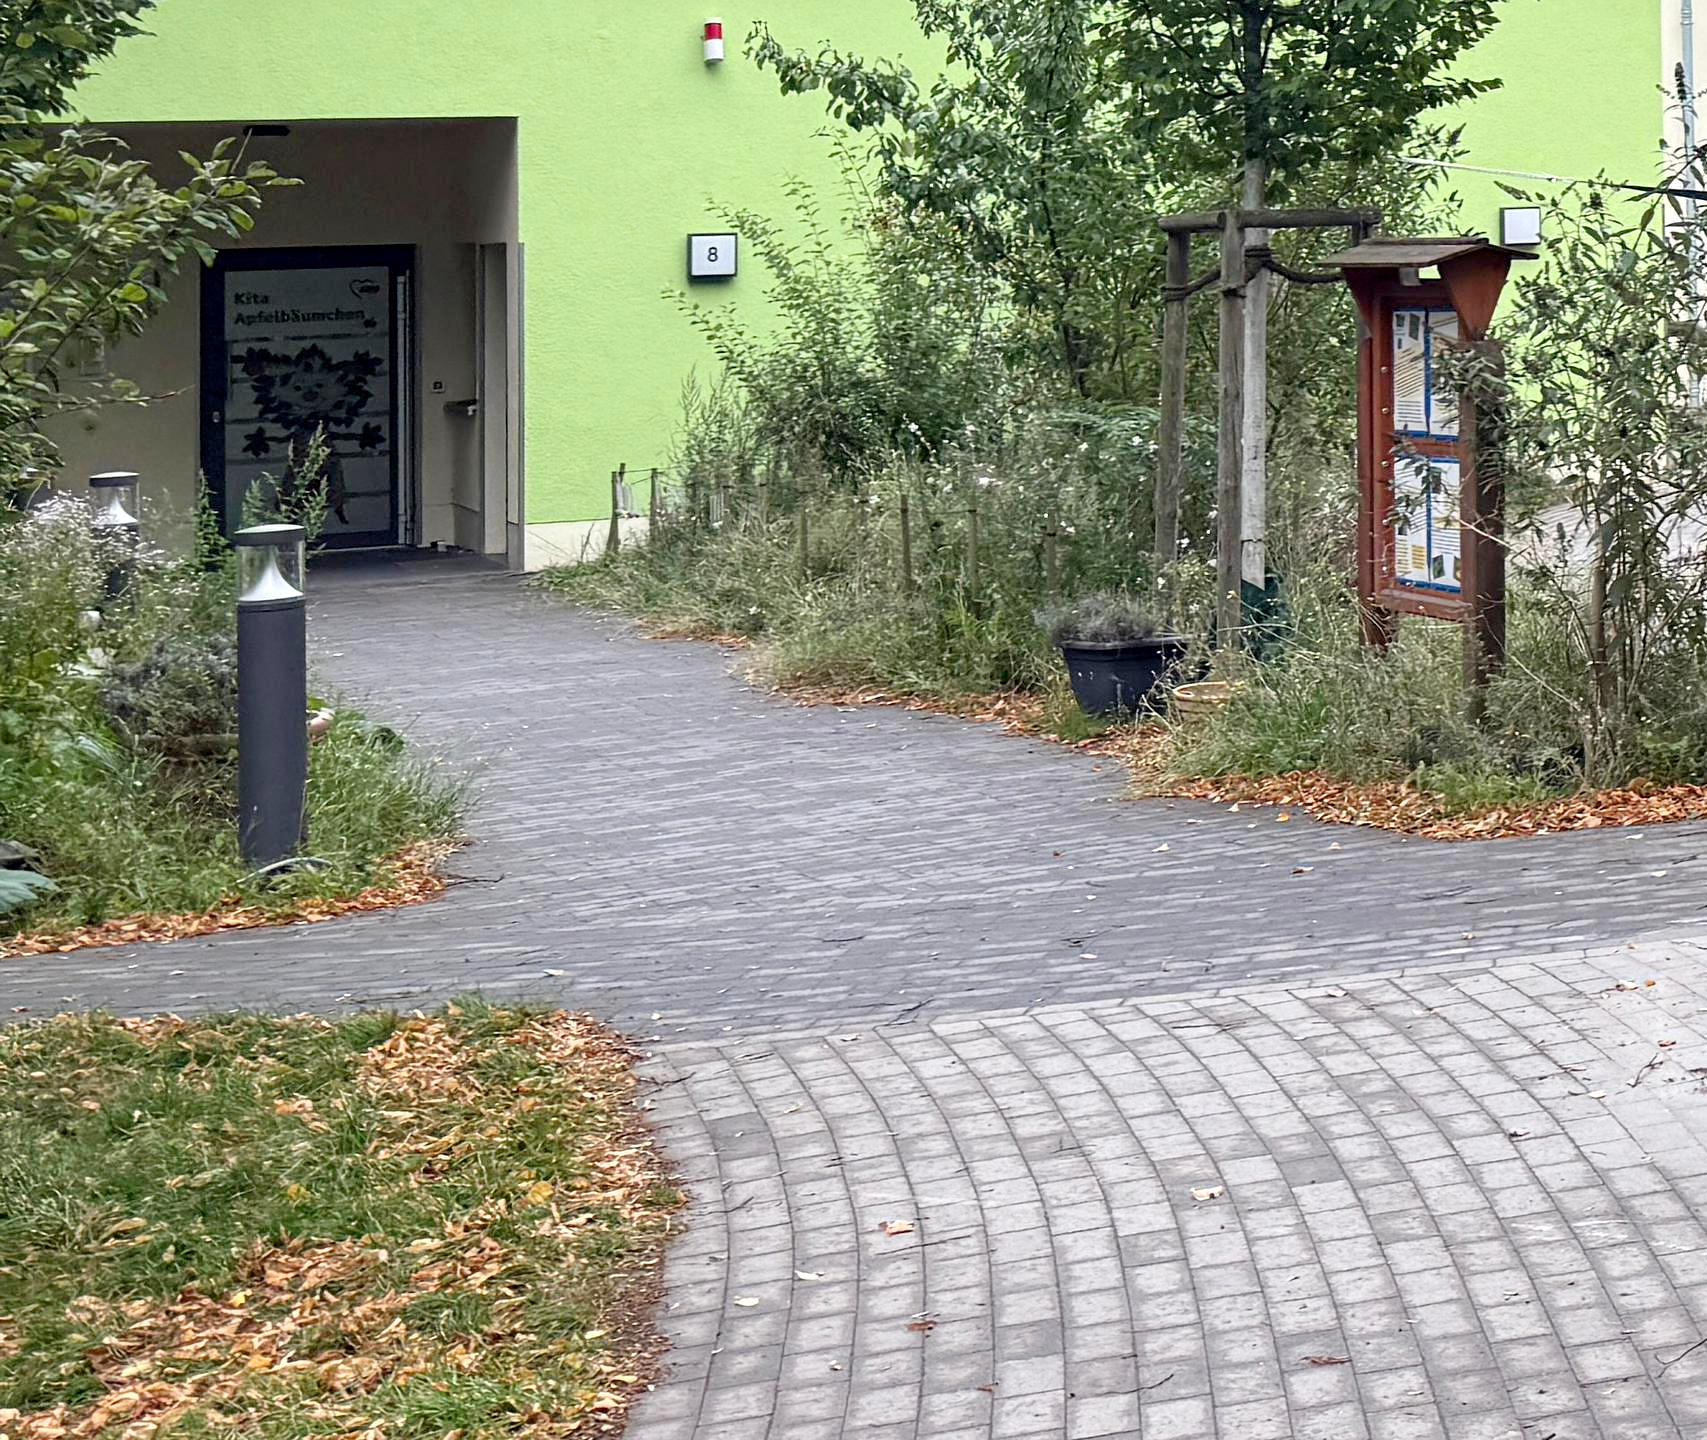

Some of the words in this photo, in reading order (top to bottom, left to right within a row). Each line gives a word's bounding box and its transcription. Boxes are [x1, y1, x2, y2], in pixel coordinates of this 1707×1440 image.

[707, 246, 718, 262] 8
[234, 292, 269, 305] Kita
[234, 308, 365, 326] Apfelbäumchen
